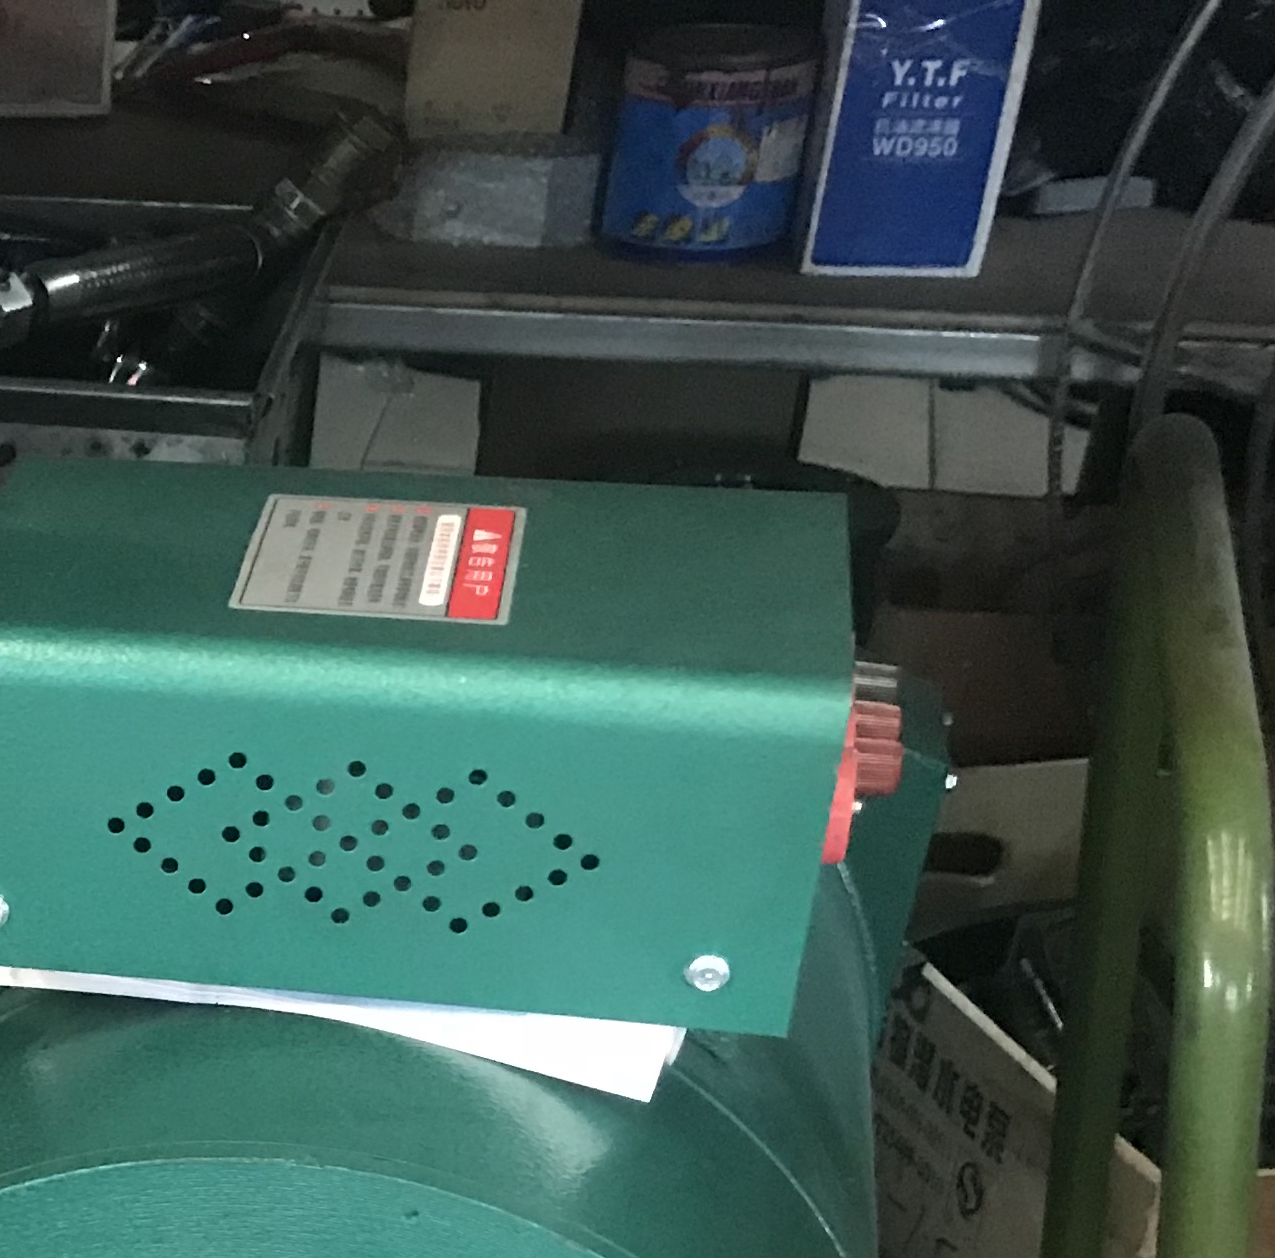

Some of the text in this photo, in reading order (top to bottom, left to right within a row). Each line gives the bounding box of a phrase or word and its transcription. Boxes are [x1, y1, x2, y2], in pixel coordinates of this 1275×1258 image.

[891, 58, 971, 87] Y.T.F
[881, 91, 964, 109] Filter
[871, 136, 959, 157] WD950
